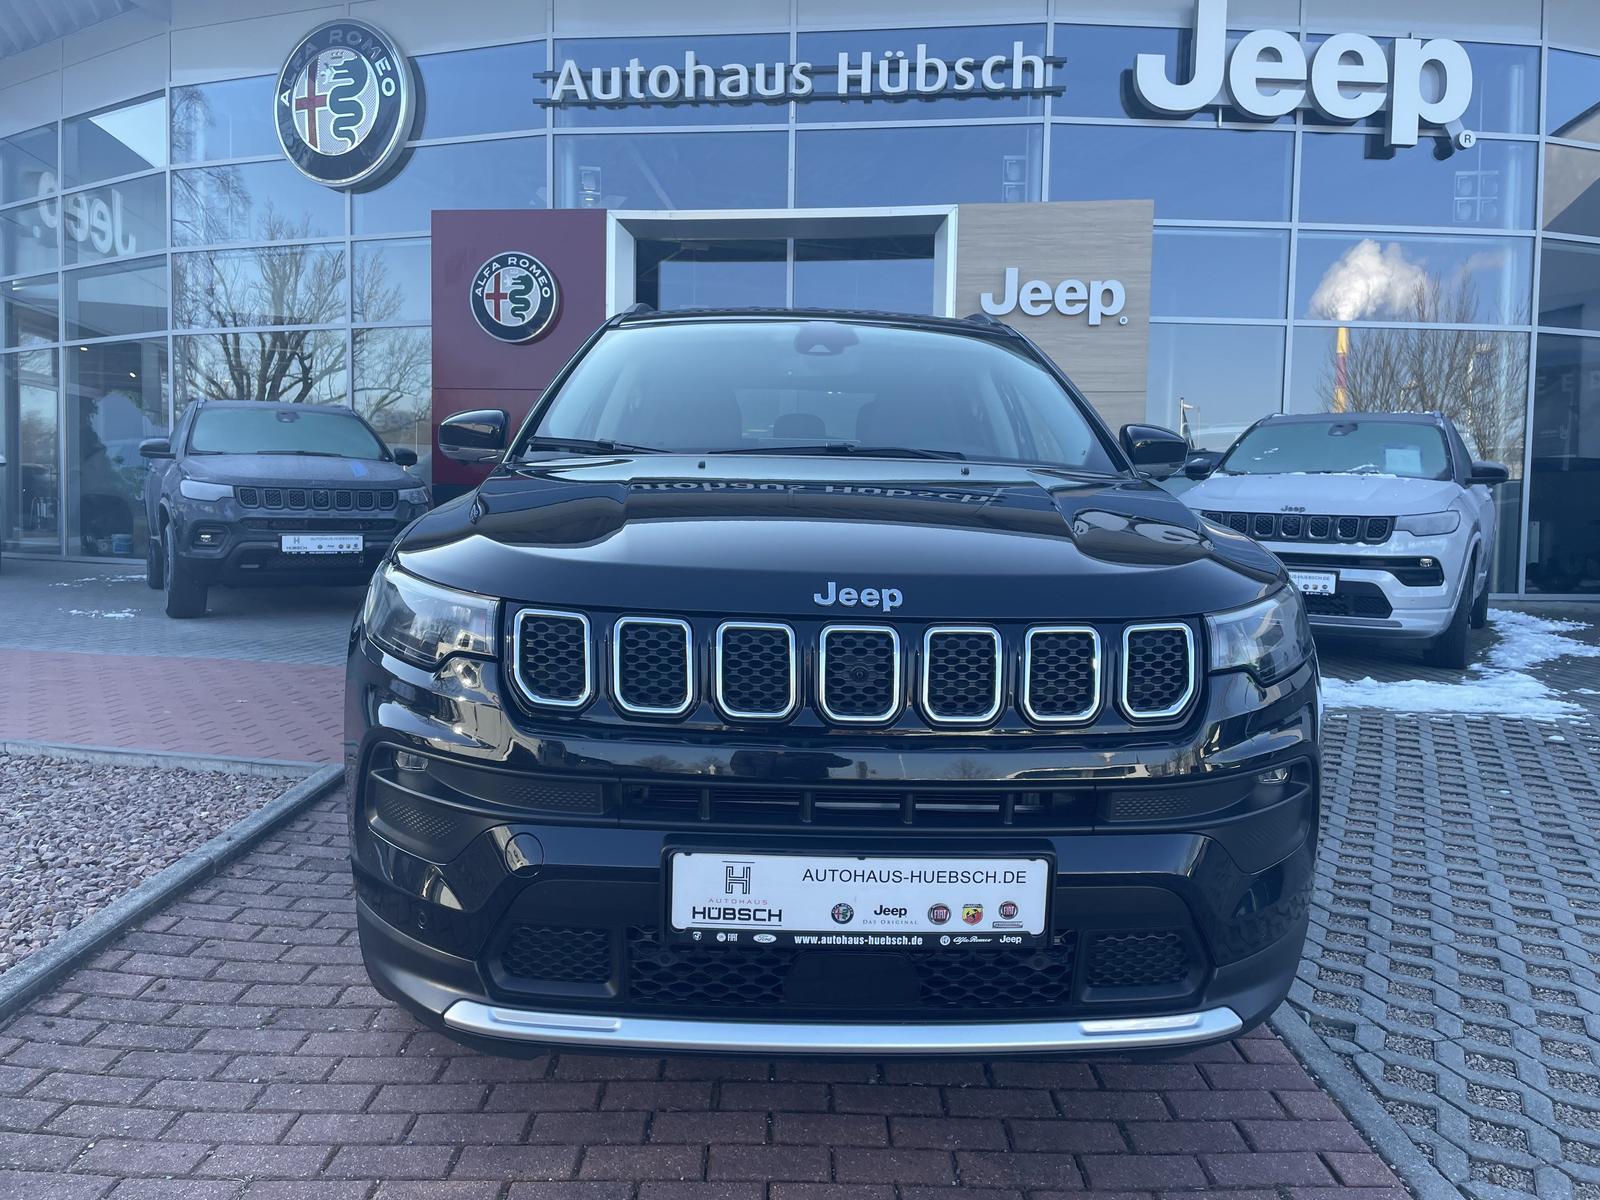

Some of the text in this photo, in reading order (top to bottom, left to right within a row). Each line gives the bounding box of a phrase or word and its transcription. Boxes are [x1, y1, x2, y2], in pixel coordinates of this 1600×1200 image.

[280, 29, 396, 107] ALFA ROMEO
[550, 40, 1045, 101] Autohaus Hübsch
[1135, 0, 1473, 147] Jeep
[475, 256, 551, 298] ALFA ROMEO
[980, 267, 1126, 325] Jeep
[1280, 505, 1306, 513] Jeep
[813, 581, 904, 613] Jeep
[801, 868, 1027, 884] AUTOHAUS-HUEBSCH.DE
[708, 898, 768, 906] AUTOHAUS
[692, 906, 783, 922] HÜBSCH
[873, 904, 908, 918] Jeep
[794, 935, 923, 946] www.autohaus-huebsch.de
[999, 934, 1023, 944] Jeep
